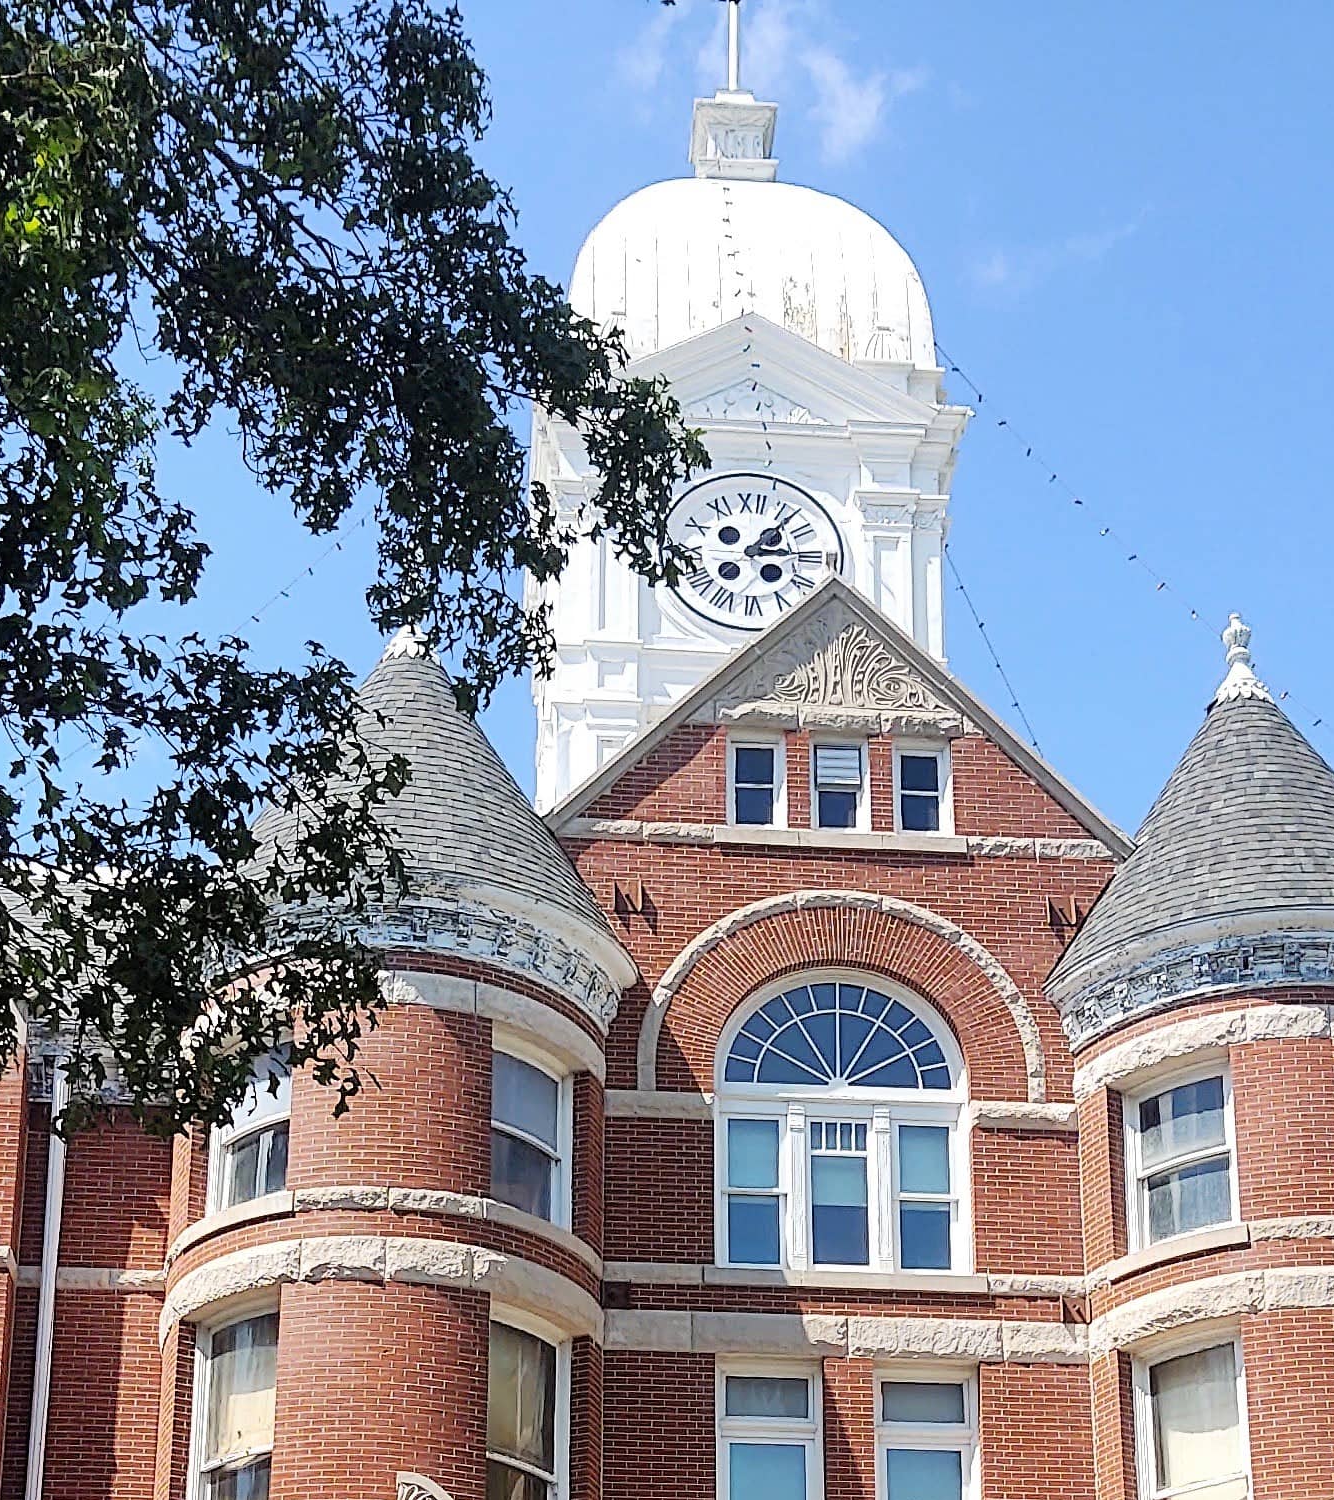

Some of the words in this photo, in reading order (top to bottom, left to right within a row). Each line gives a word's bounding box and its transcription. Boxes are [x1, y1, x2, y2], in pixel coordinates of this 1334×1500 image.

[706, 495, 733, 521] XI
[737, 493, 767, 515] XII
[685, 516, 711, 537] X
[789, 523, 815, 539] II
[798, 551, 823, 564] III
[709, 586, 734, 613] VII
[745, 596, 764, 617] VI
